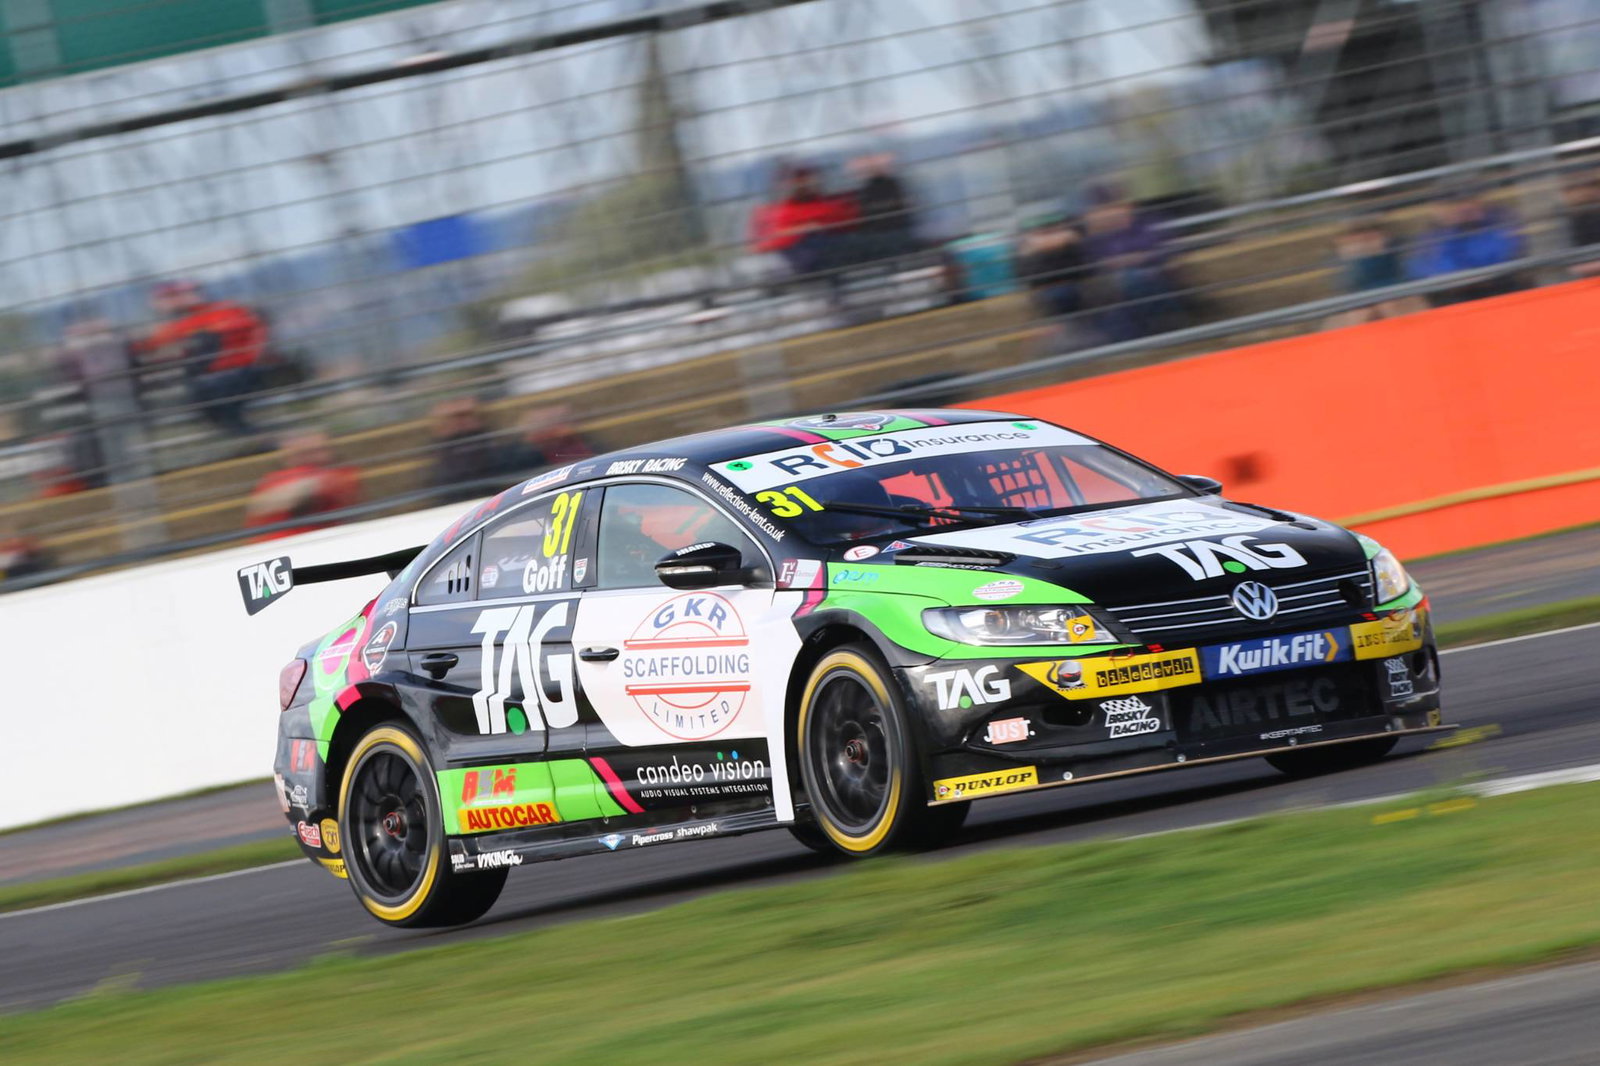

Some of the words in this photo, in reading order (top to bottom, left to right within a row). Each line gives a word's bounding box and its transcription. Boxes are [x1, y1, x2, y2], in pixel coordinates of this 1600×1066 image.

[904, 430, 1030, 449] Insurance
[605, 459, 645, 475] BRISKY
[642, 458, 688, 473] RACING
[702, 472, 785, 542] www.reflections-kent.co.uk
[755, 486, 825, 518] 31
[543, 491, 582, 558] 31
[1131, 535, 1308, 581] TAG
[240, 558, 292, 600] TAG
[522, 555, 569, 594] Goff
[653, 598, 727, 631] GKR
[470, 602, 579, 735] TAG
[623, 653, 749, 678] SCAFFOLDING
[1096, 656, 1194, 688] bikedevil
[923, 665, 1011, 711] TAG
[1189, 677, 1340, 731] AIRTEC
[653, 699, 730, 729] LIMITED
[1108, 709, 1147, 722] BRISKY
[1113, 720, 1159, 736] RACING
[636, 755, 704, 785] candeo
[709, 750, 765, 781] vision
[954, 771, 1032, 792] DUNLOP
[640, 789, 662, 798] AUDIO
[664, 788, 689, 797] VISUAL
[689, 786, 720, 796] SYSTEMS
[721, 783, 769, 793] INTEGRATION
[466, 803, 559, 830] AUTOCAR
[632, 831, 674, 846] Pipercross
[676, 822, 718, 836] shawpak
